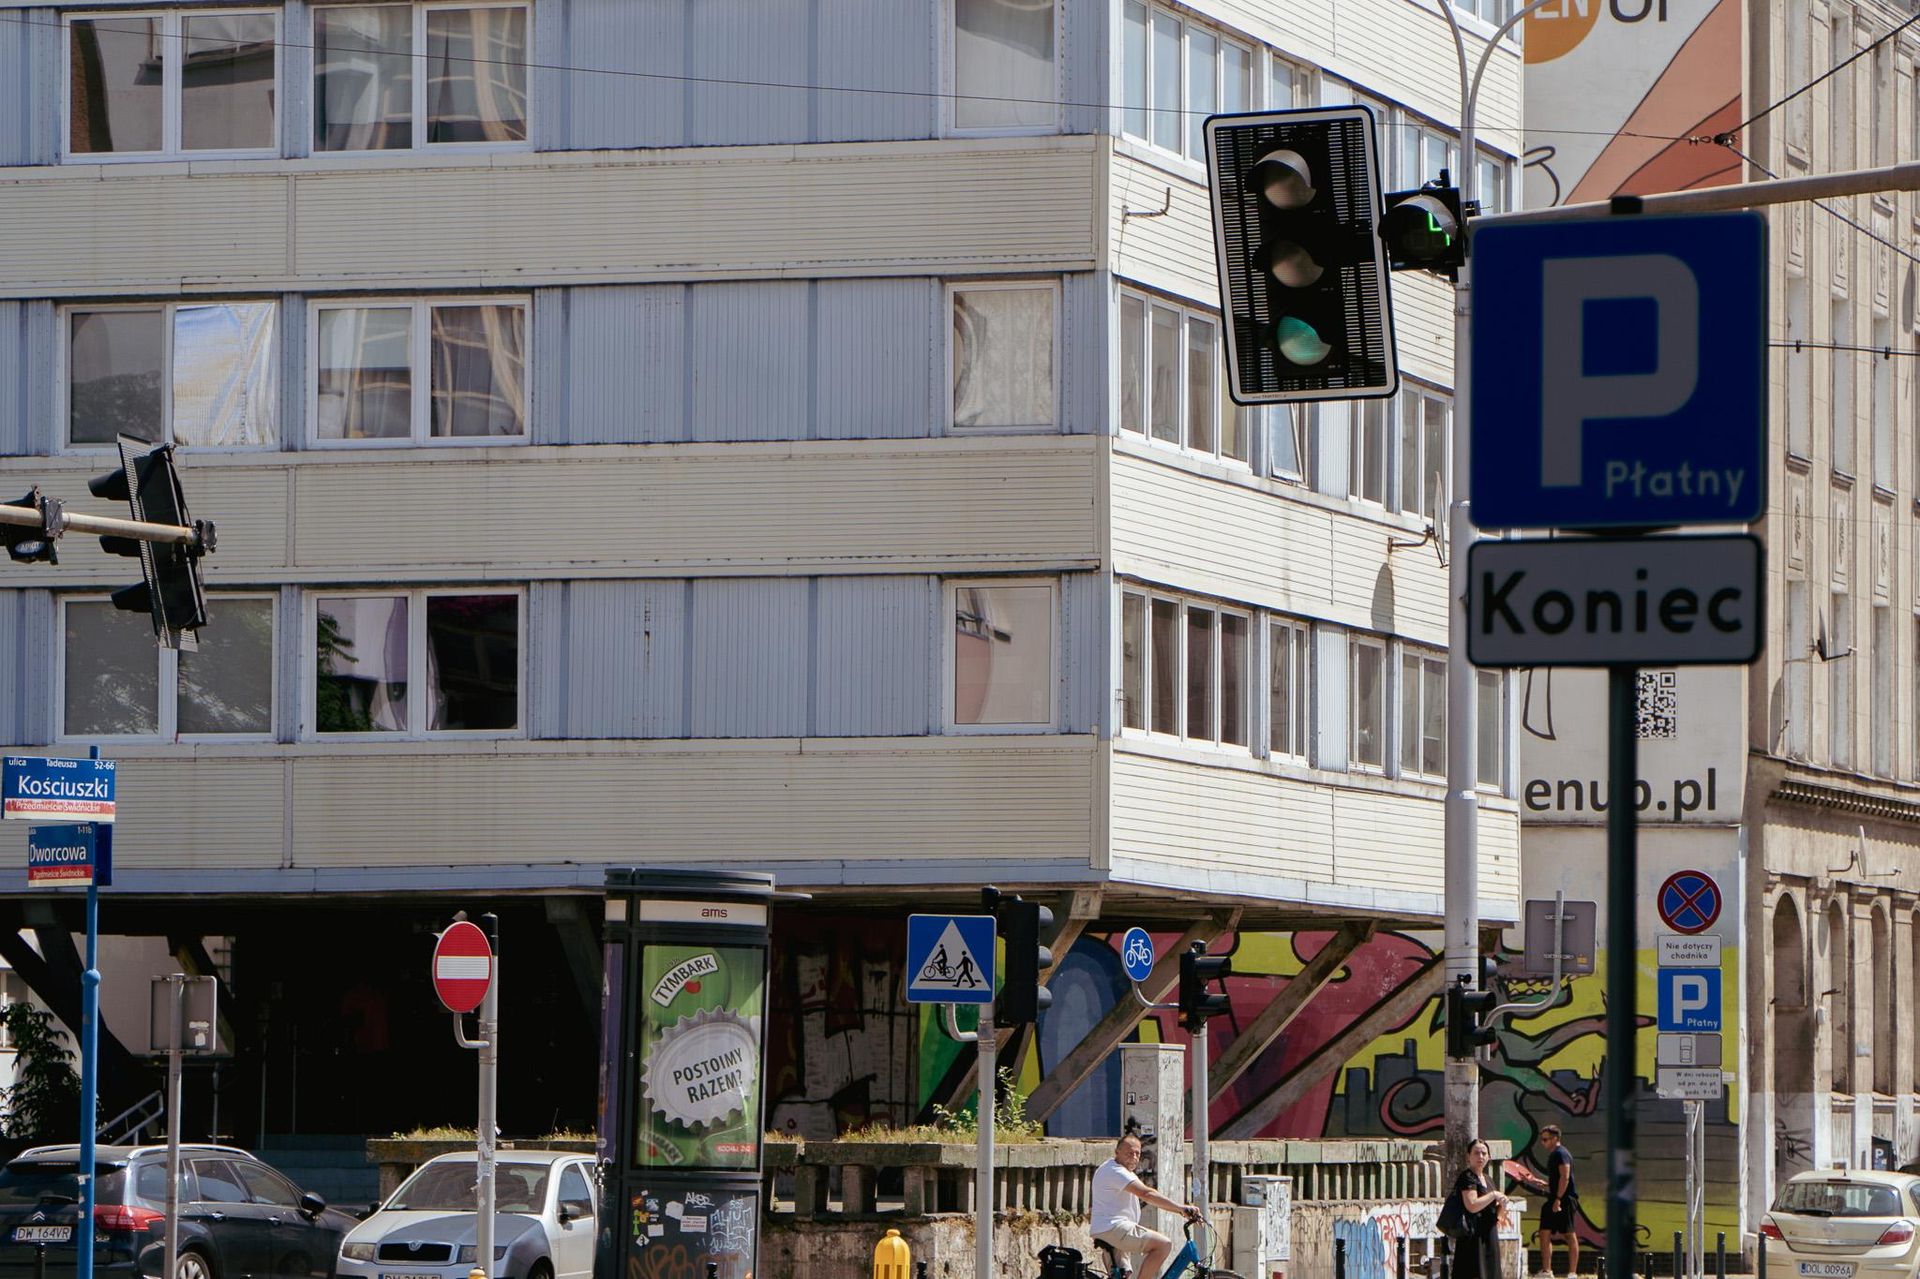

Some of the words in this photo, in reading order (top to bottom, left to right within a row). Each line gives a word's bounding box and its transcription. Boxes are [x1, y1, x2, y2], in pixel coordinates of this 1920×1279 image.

[1541, 253, 1699, 487] P
[1606, 461, 1745, 506] Płatny
[1481, 568, 1743, 635] Koniec
[8, 758, 27, 766] ulica
[46, 759, 77, 768] Tadeusza
[94, 761, 115, 770] 52-66
[18, 775, 108, 798] Kościuszki
[29, 845, 86, 862] Dworcowa
[701, 908, 728, 918] ams
[1670, 952, 1708, 960] chodnika
[1682, 943, 1713, 951] dotyczy
[655, 957, 714, 1000] TYMBARK
[1672, 975, 1708, 1024] P
[1687, 1018, 1719, 1029] Płatny
[673, 1048, 743, 1085] POSTOIMY
[687, 1069, 743, 1104] RAZEM?
[17, 1228, 34, 1239] DW
